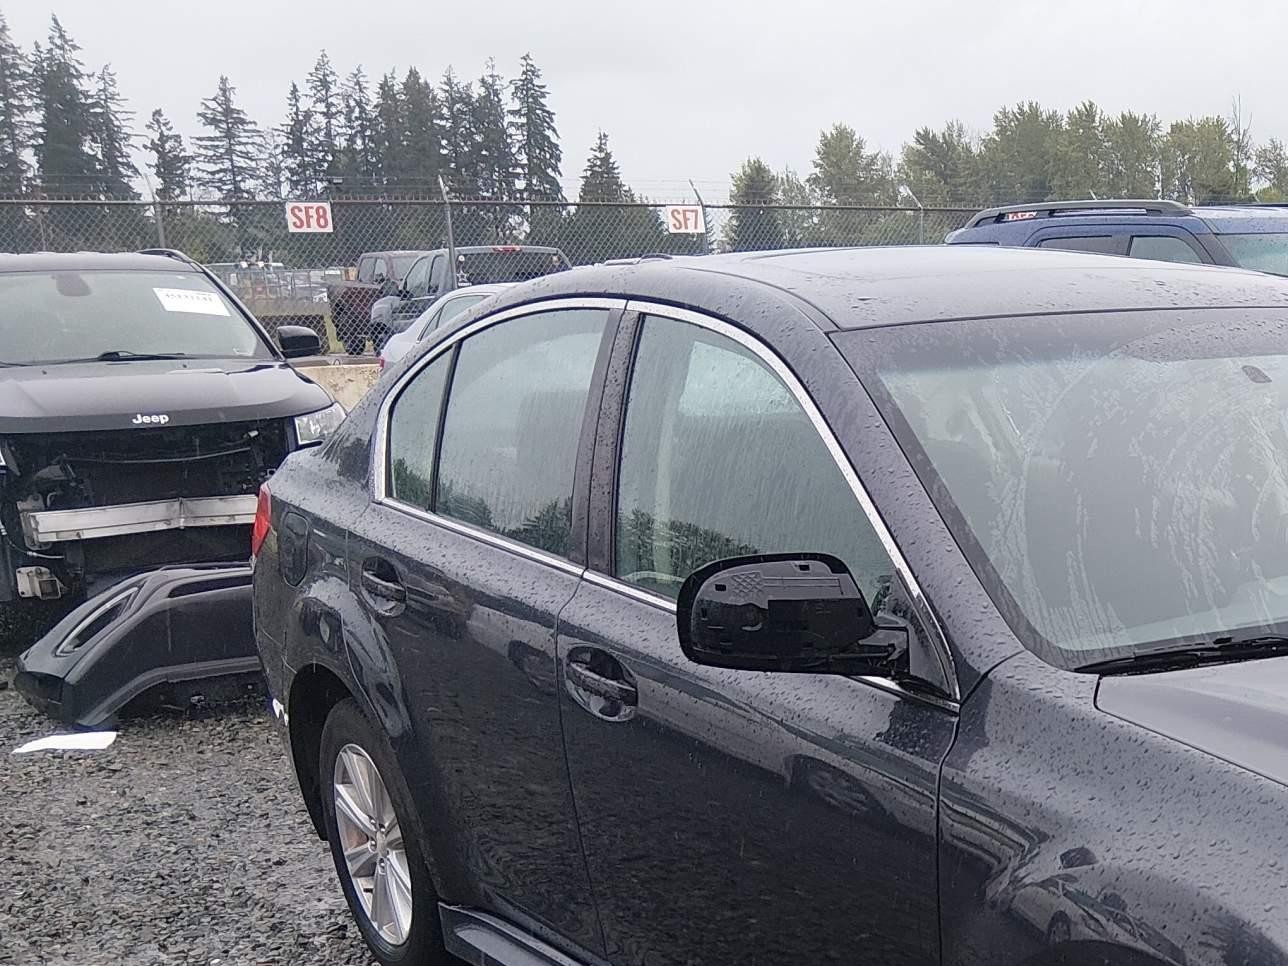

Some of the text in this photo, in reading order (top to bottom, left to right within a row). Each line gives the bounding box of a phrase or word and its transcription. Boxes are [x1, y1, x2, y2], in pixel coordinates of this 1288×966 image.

[290, 205, 329, 229] SF8
[671, 208, 699, 230] SF7
[132, 413, 170, 425] Jeep
